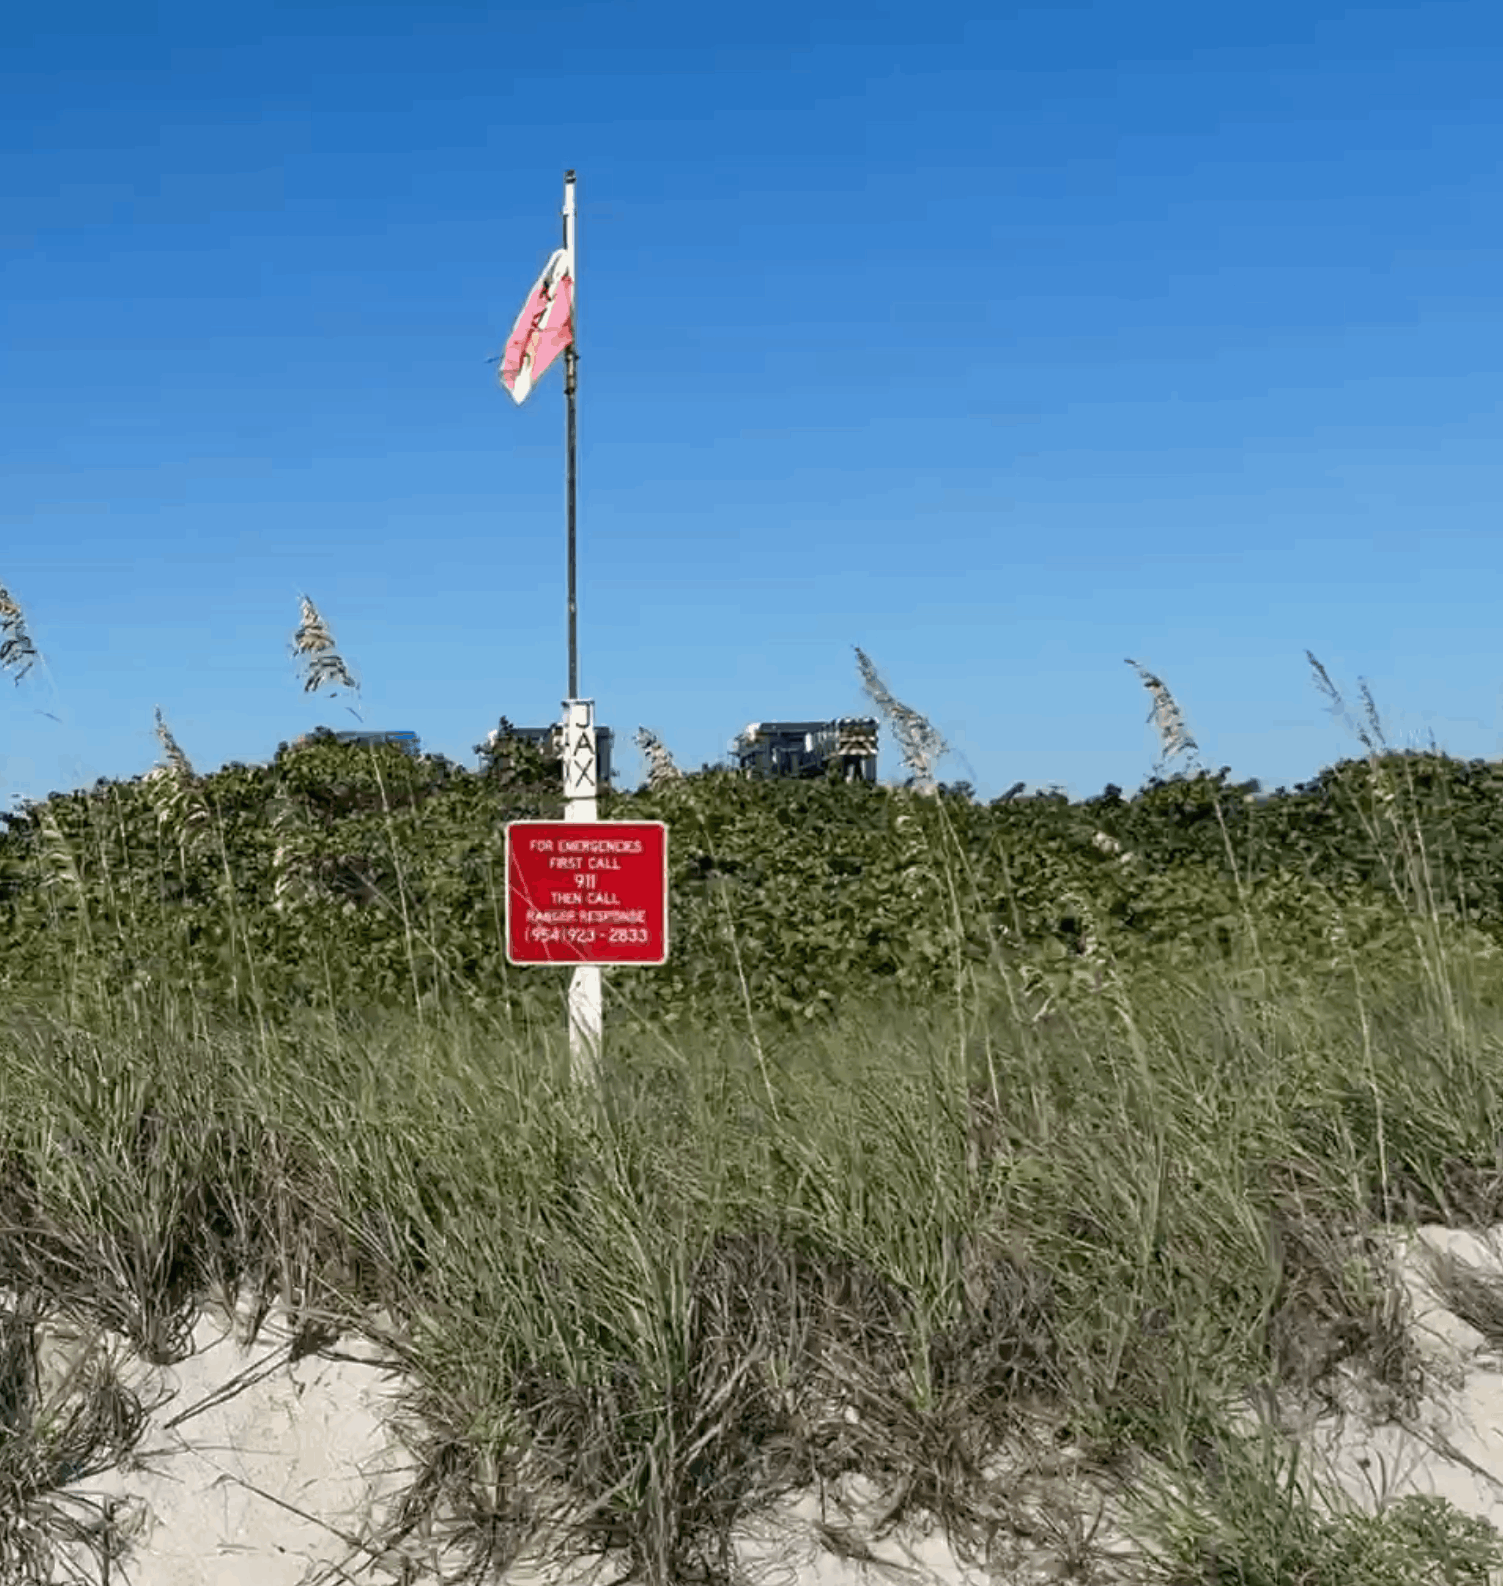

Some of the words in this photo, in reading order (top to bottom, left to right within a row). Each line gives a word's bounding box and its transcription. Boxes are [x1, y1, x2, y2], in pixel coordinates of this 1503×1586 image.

[574, 702, 596, 787] JAX
[529, 839, 554, 852] FOR
[549, 857, 583, 870] FIRST
[588, 857, 621, 870] CALL
[574, 874, 596, 889] 911
[551, 892, 582, 905] THEN
[587, 892, 621, 905] CALL
[608, 927, 648, 943] 2833
